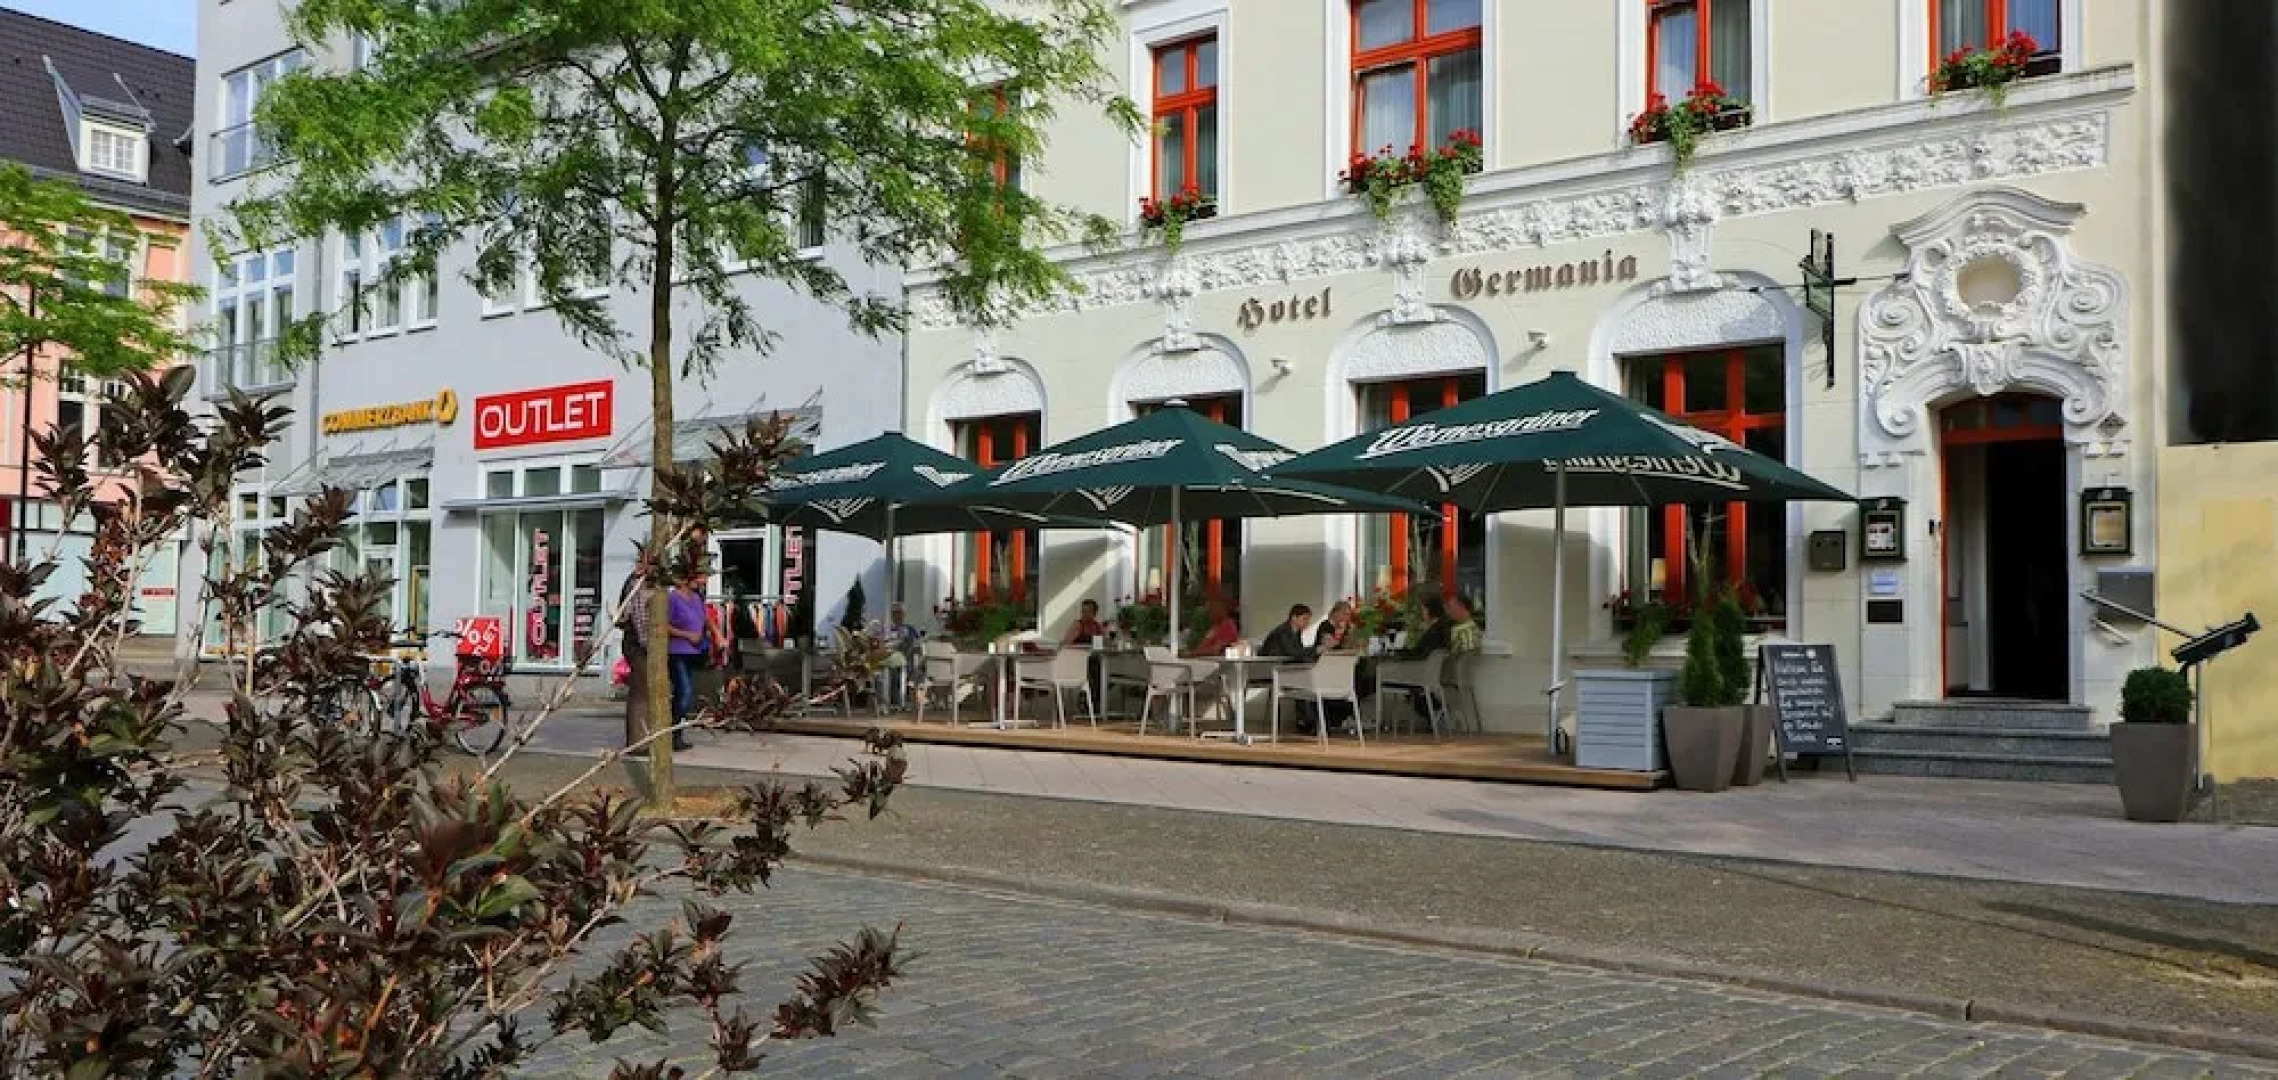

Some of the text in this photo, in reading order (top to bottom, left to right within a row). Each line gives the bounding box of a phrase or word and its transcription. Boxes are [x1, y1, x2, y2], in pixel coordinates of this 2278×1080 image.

[1236, 249, 1638, 333] Hotel Germania
[479, 391, 606, 438] OUTLET
